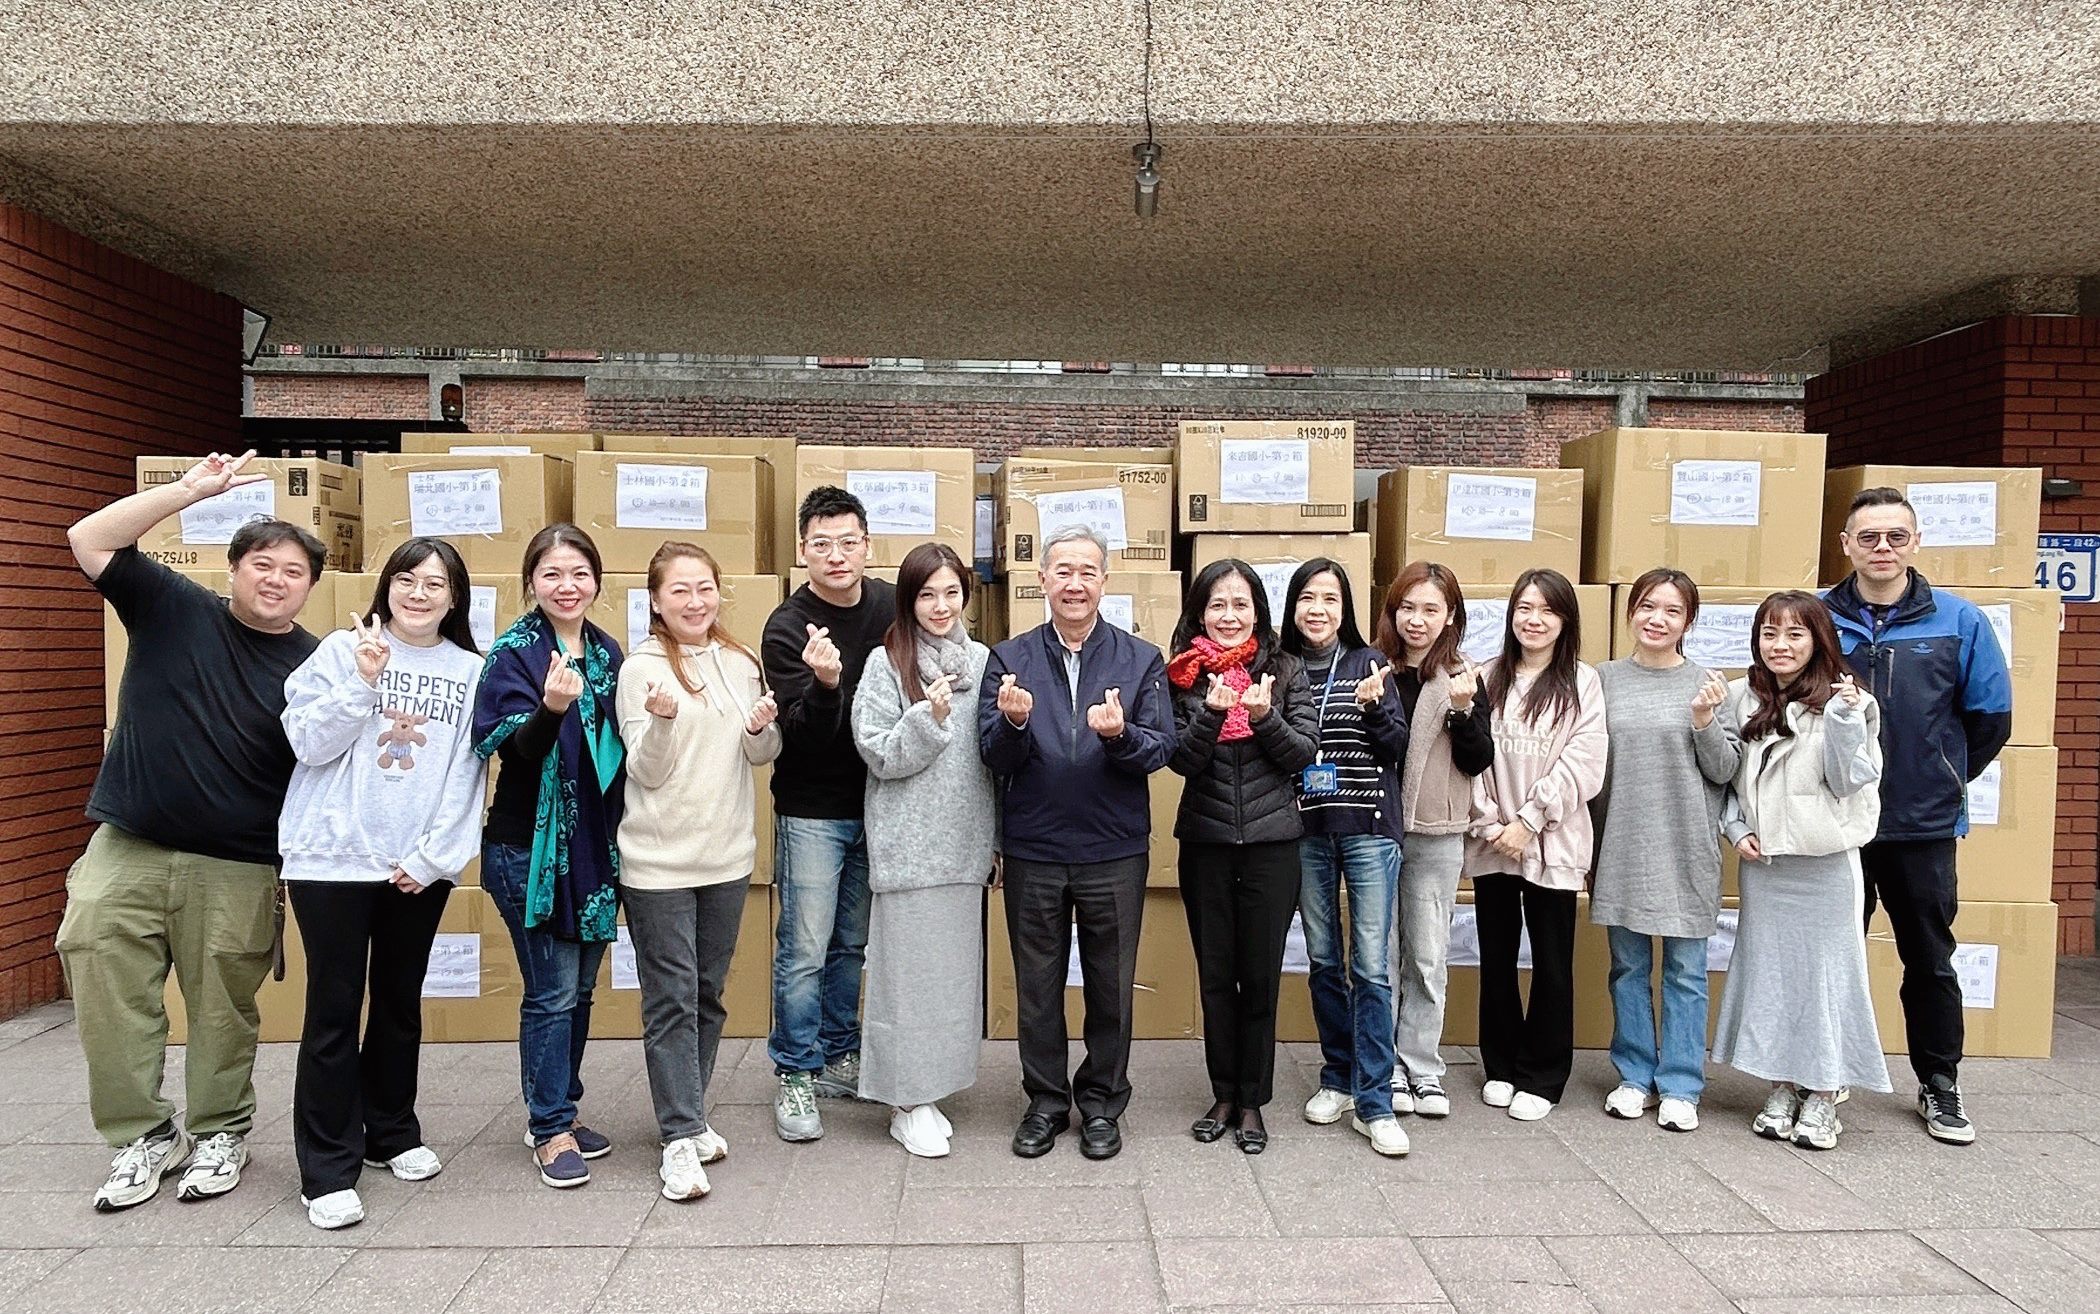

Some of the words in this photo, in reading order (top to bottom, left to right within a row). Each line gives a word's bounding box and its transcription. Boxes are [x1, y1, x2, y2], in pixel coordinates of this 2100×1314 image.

[1297, 427, 1347, 440] 81920-00
[1118, 471, 1167, 484] 81752-00
[2034, 561, 2077, 592] 46
[380, 669, 412, 694] RIS
[416, 674, 467, 705] PETS
[371, 692, 463, 728] ARTMENT
